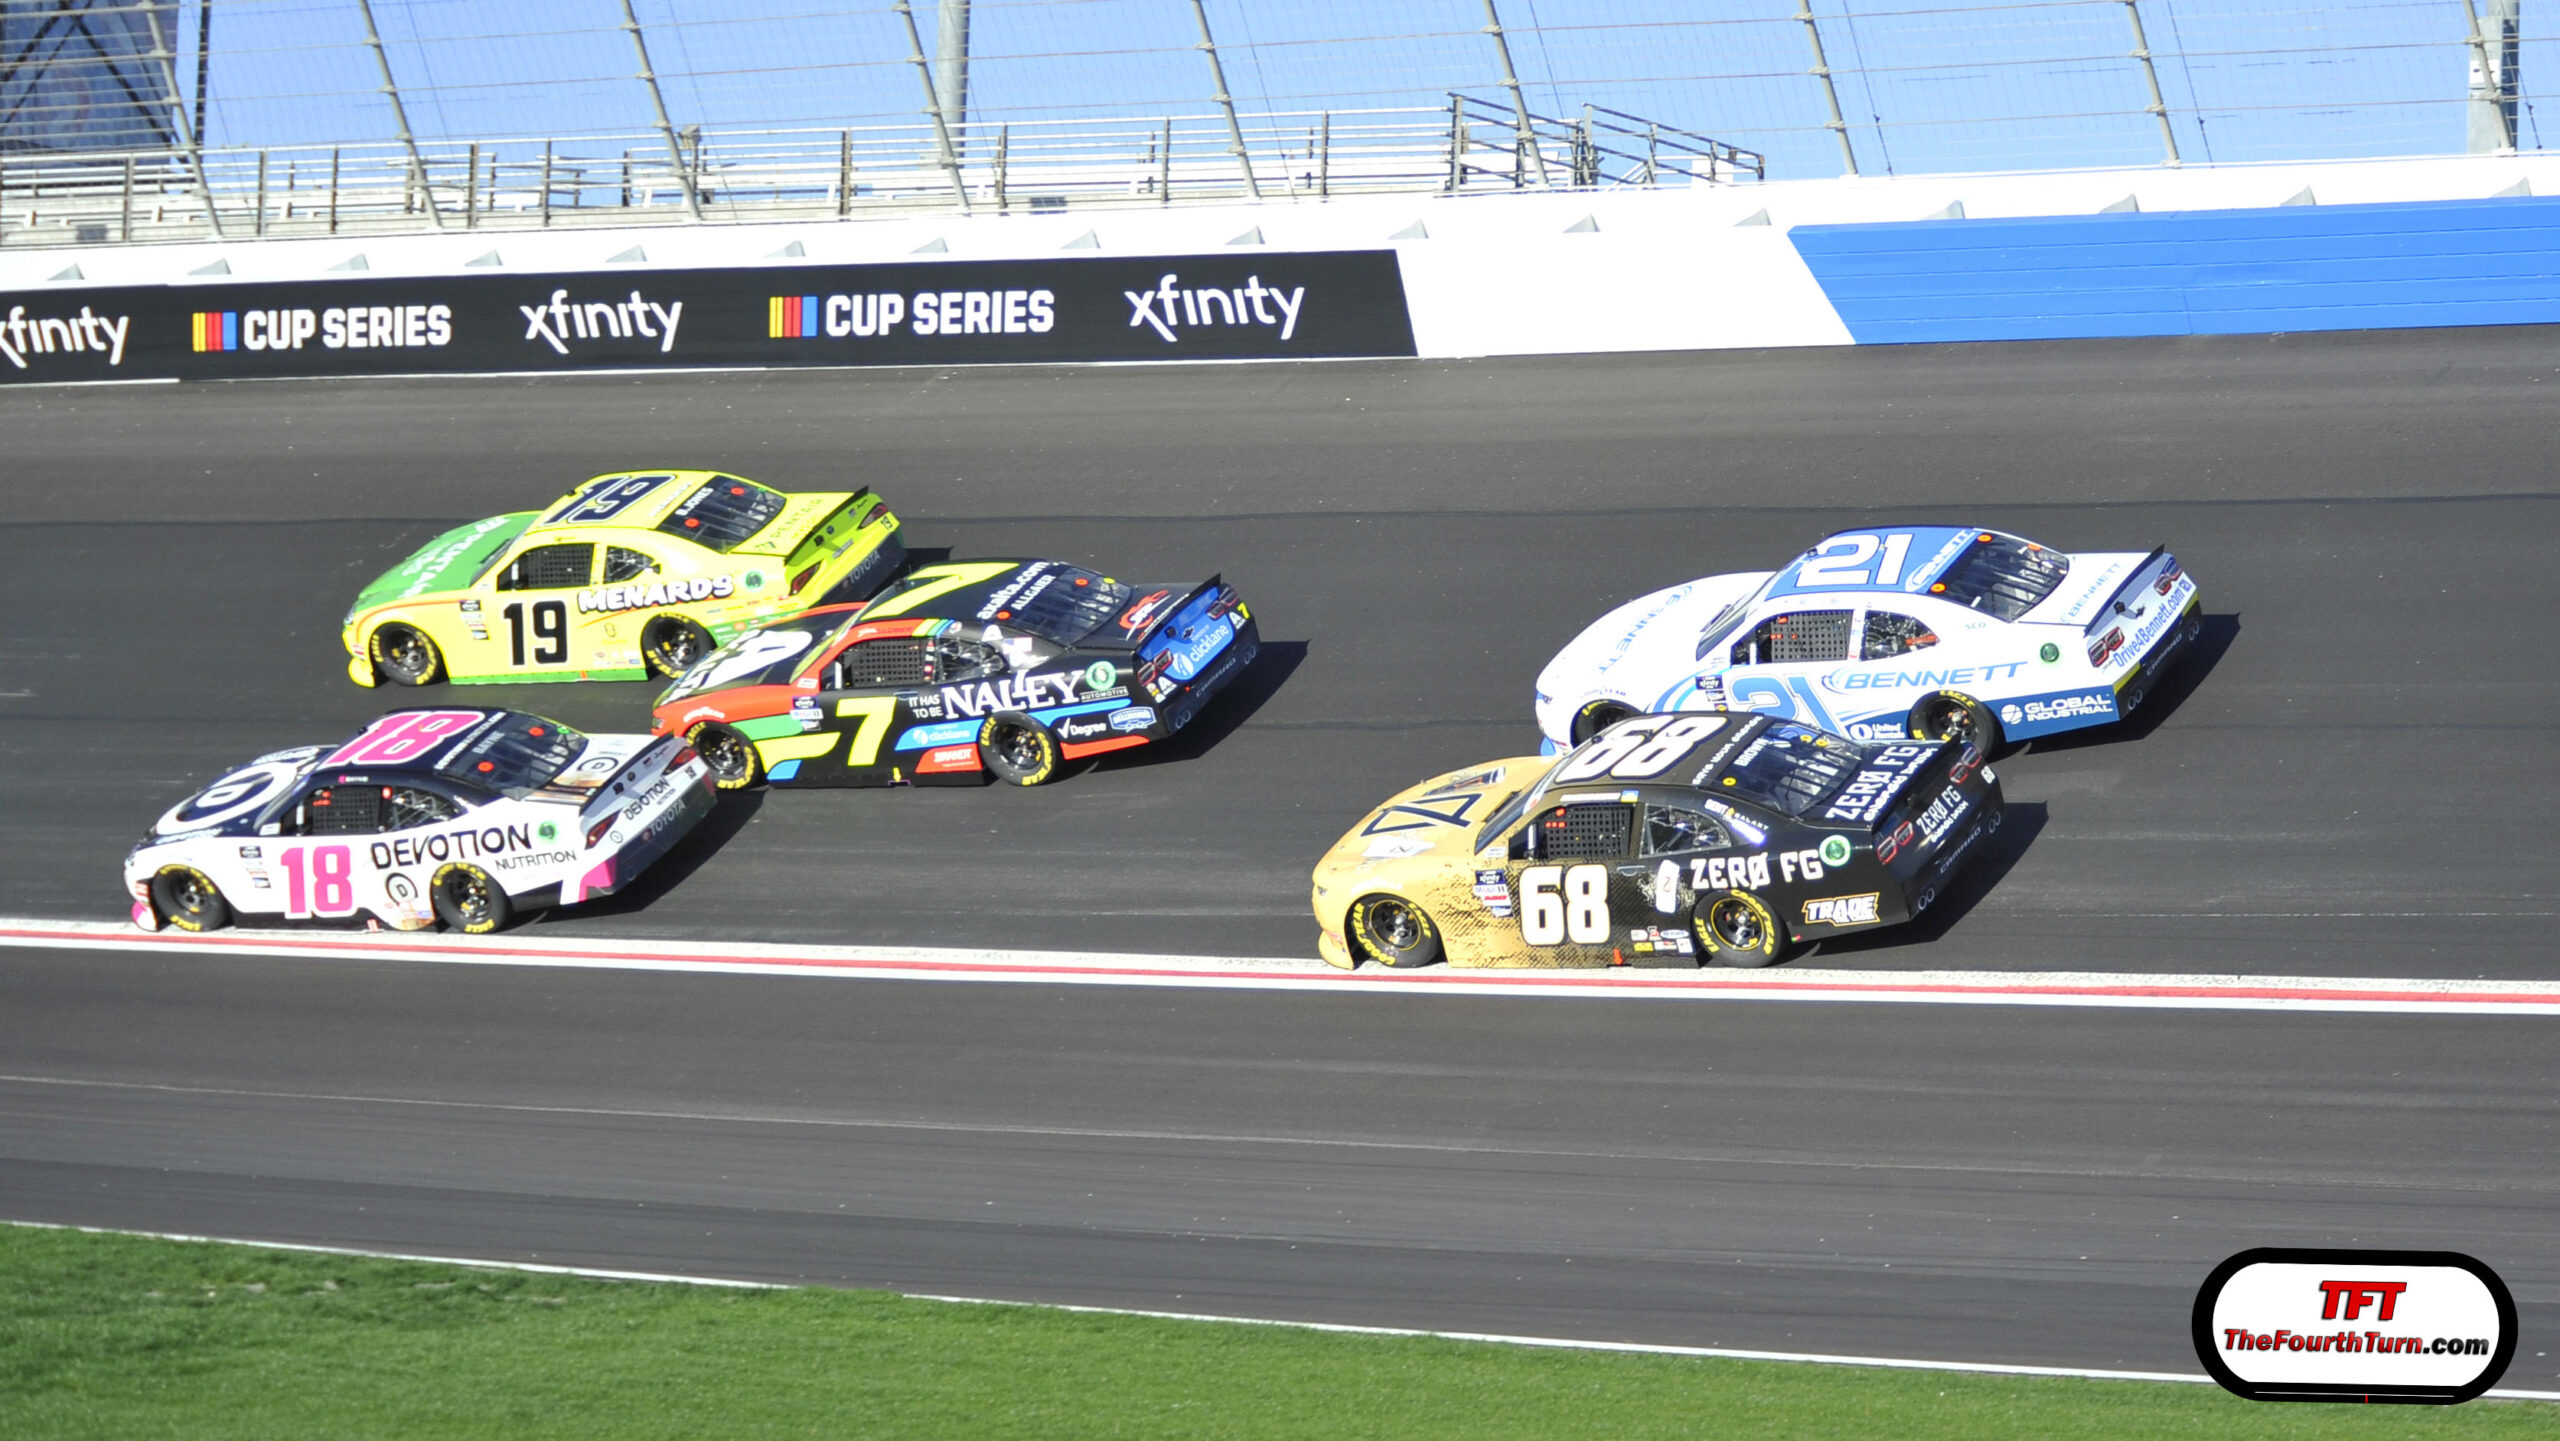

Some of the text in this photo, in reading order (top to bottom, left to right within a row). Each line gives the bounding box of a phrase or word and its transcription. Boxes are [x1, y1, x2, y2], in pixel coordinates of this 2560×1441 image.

[243, 304, 452, 350] CUP SERIES
[519, 289, 683, 354] xfinity
[825, 289, 1055, 337] CUP SERIES
[1124, 274, 1305, 341] xfinity
[541, 474, 677, 526] 19
[849, 550, 881, 585] TOYOTA
[1795, 533, 1915, 588] 21
[577, 574, 735, 614] MENARDS
[860, 562, 1021, 621] 7
[1011, 574, 1057, 611] ALLGAIER
[2068, 562, 2121, 618] BENNETT
[1237, 602, 1250, 619] 7
[2113, 589, 2186, 668] Drive4Bennett.com
[503, 600, 568, 666] 19
[1190, 624, 1230, 662] clicklane
[941, 669, 1085, 719] NALLEY
[1081, 686, 1129, 701] AUTOMOTIVE
[1844, 661, 2028, 689] BENNETT
[909, 694, 940, 708] IT HAS
[913, 706, 944, 718] TO BE
[2024, 694, 2111, 715] GLOBAL
[2027, 705, 2113, 722] INDUSTRIAL
[315, 710, 486, 771] 18
[836, 696, 897, 767] 7
[981, 717, 997, 746] EAGLE
[1070, 720, 1106, 736] Degree
[1554, 715, 1728, 783] 68
[1734, 737, 1770, 767] BROWN
[1873, 747, 1919, 767] FG
[1980, 765, 1996, 784] 68
[623, 777, 671, 821] DEVOTION
[1941, 785, 1962, 808] FG
[650, 798, 687, 836] TOYOTA
[371, 823, 532, 869] DEVOTION
[495, 850, 577, 870] NUTRITION
[1780, 849, 1824, 883] FG
[281, 845, 353, 915] 18
[1519, 864, 1610, 946] 68
[1730, 889, 1775, 955] GOODYEAR
[1353, 903, 1396, 966] GOODYEAR
[1694, 917, 1720, 952] EAGLE
